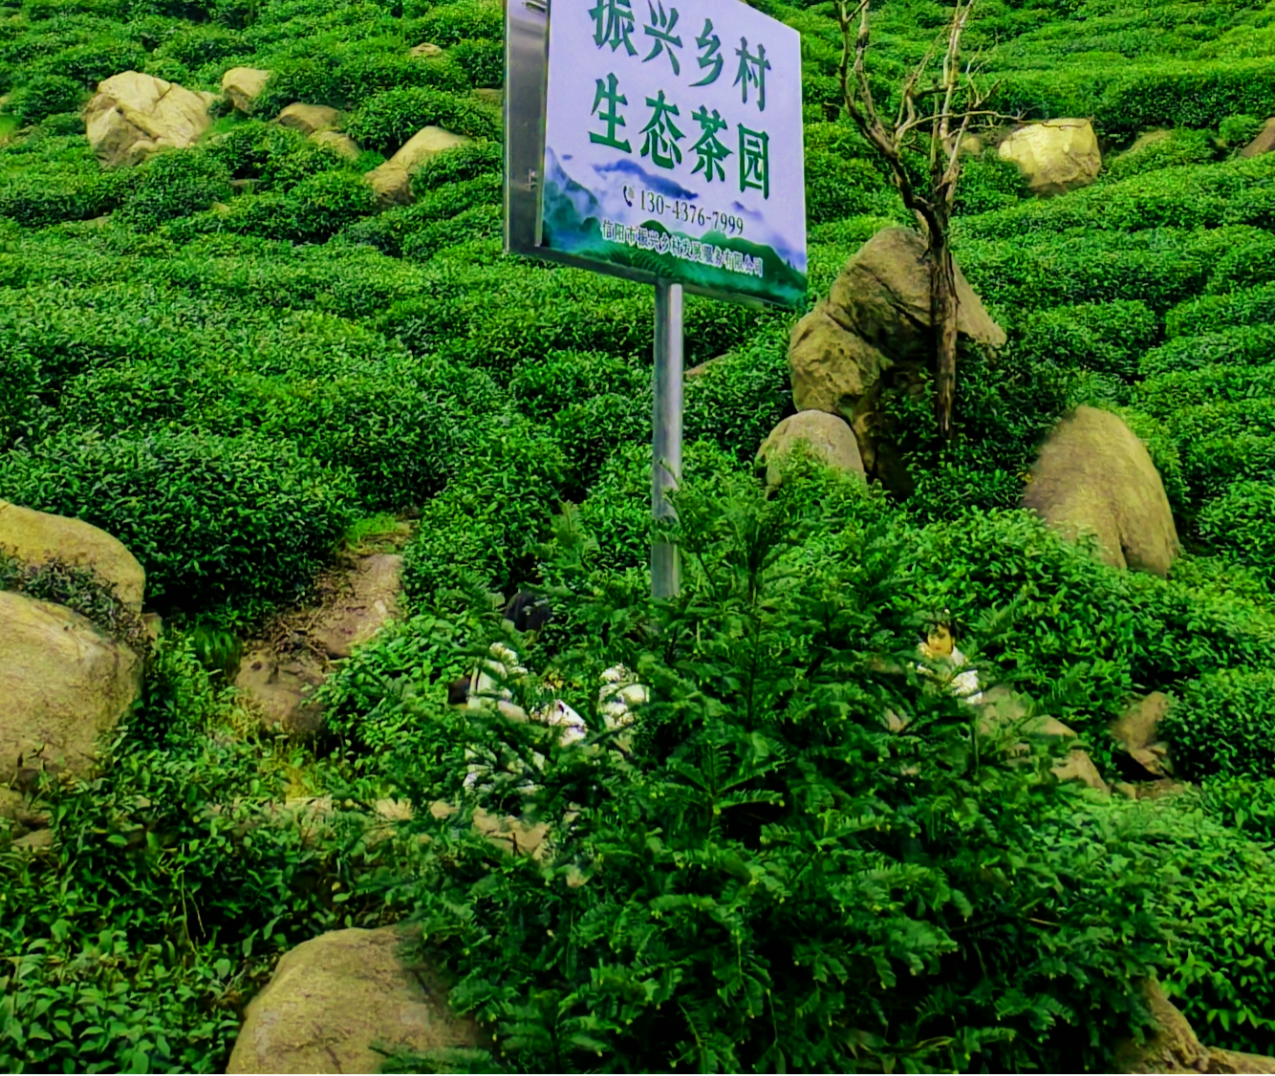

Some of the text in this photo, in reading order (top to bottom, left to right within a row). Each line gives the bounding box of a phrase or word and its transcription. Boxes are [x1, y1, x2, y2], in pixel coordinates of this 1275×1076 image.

[588, 72, 770, 200] 生态茶园
[640, 189, 744, 236] 130-4376-7999
